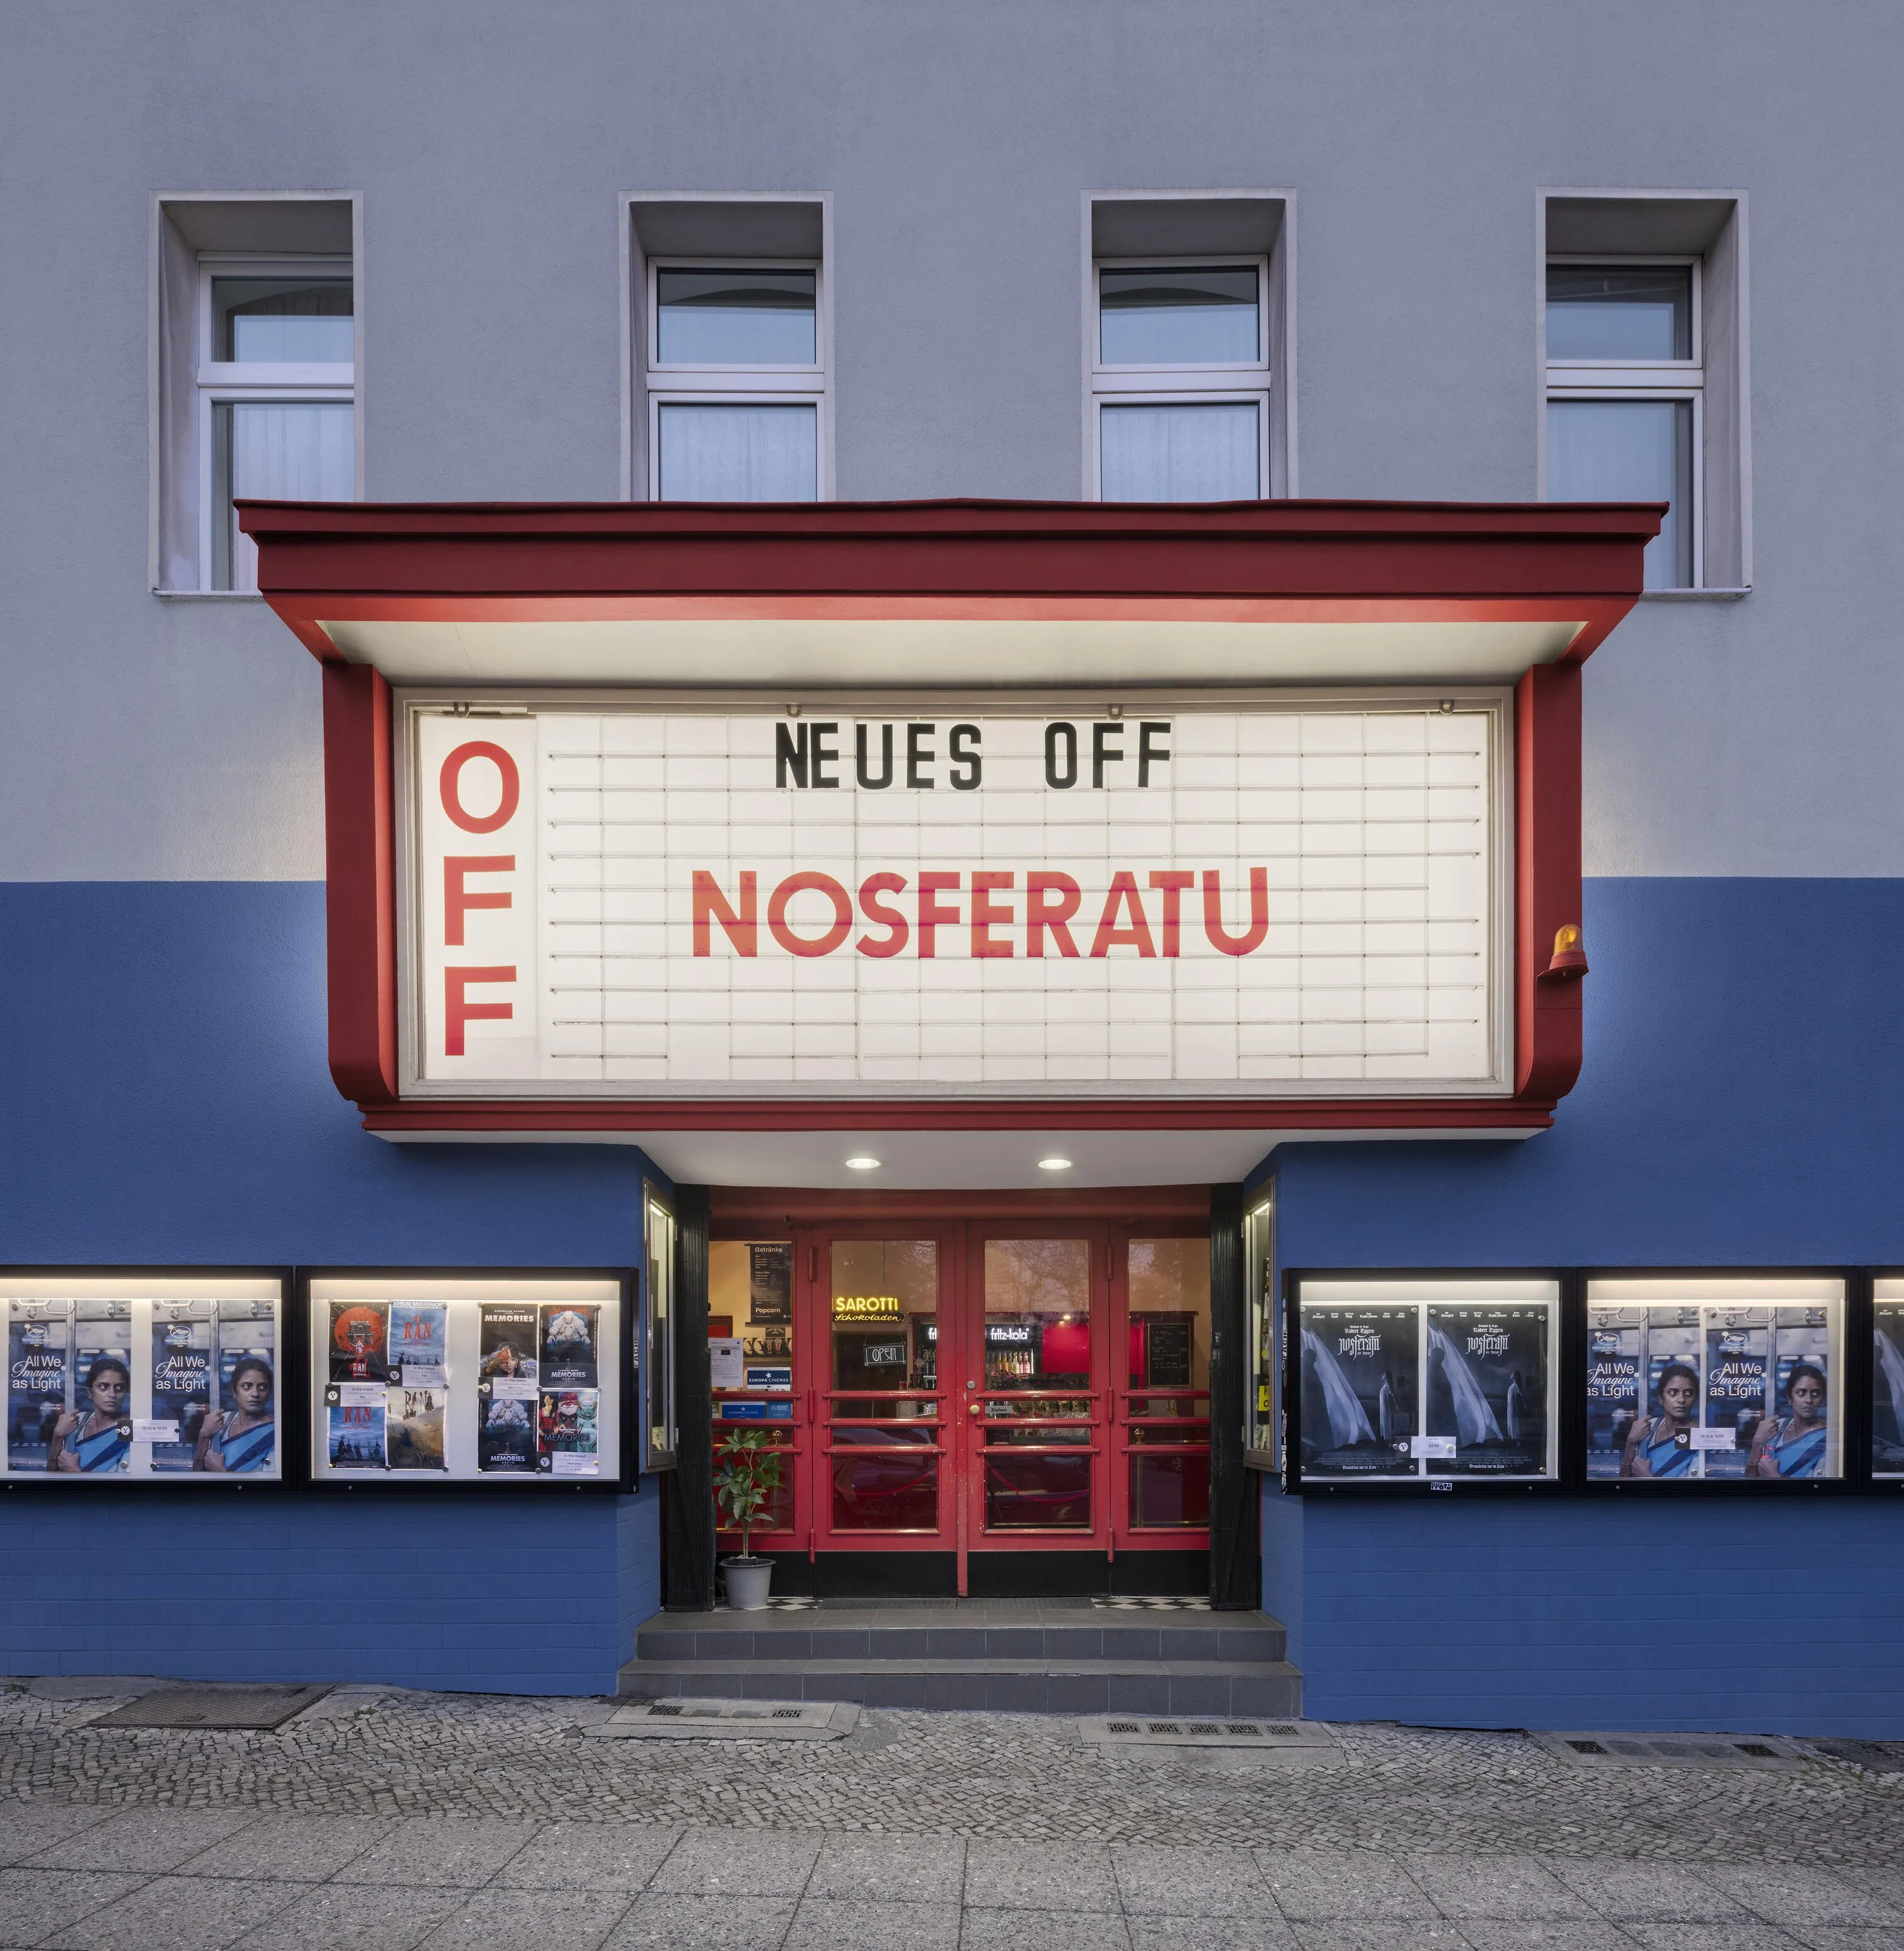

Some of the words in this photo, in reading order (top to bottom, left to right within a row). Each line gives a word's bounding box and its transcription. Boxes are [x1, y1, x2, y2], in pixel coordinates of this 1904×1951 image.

[775, 722, 982, 790] NEUES
[1045, 721, 1172, 790] OFF
[439, 740, 520, 1056] OFF
[692, 867, 1269, 958] NOSFERATU
[835, 1297, 898, 1311] SAROTTI
[834, 1313, 901, 1321] Schokoladen
[404, 1322, 432, 1340] RAN
[26, 1355, 39, 1367] All
[41, 1355, 61, 1367] We
[169, 1356, 183, 1367] All
[185, 1356, 205, 1367] We
[872, 1347, 897, 1362] OPEN
[11, 1361, 60, 1383] Imagine
[155, 1362, 204, 1383] Imagine
[353, 1363, 367, 1373] RAN
[1597, 1363, 1611, 1374] All
[1613, 1363, 1634, 1374] We
[1723, 1363, 1738, 1374] All
[1741, 1363, 1762, 1374] We
[13, 1379, 28, 1389] as
[32, 1378, 61, 1391] Light
[156, 1380, 171, 1389] as
[175, 1378, 205, 1392] Light
[1588, 1369, 1634, 1390] Imagine
[1709, 1368, 1760, 1390] Imagine
[1587, 1387, 1598, 1396] as
[1602, 1385, 1634, 1398] Light
[1710, 1387, 1725, 1396] as
[1729, 1385, 1762, 1398] Light
[345, 1407, 371, 1423] RAN
[544, 1433, 591, 1442] MEMORIES
